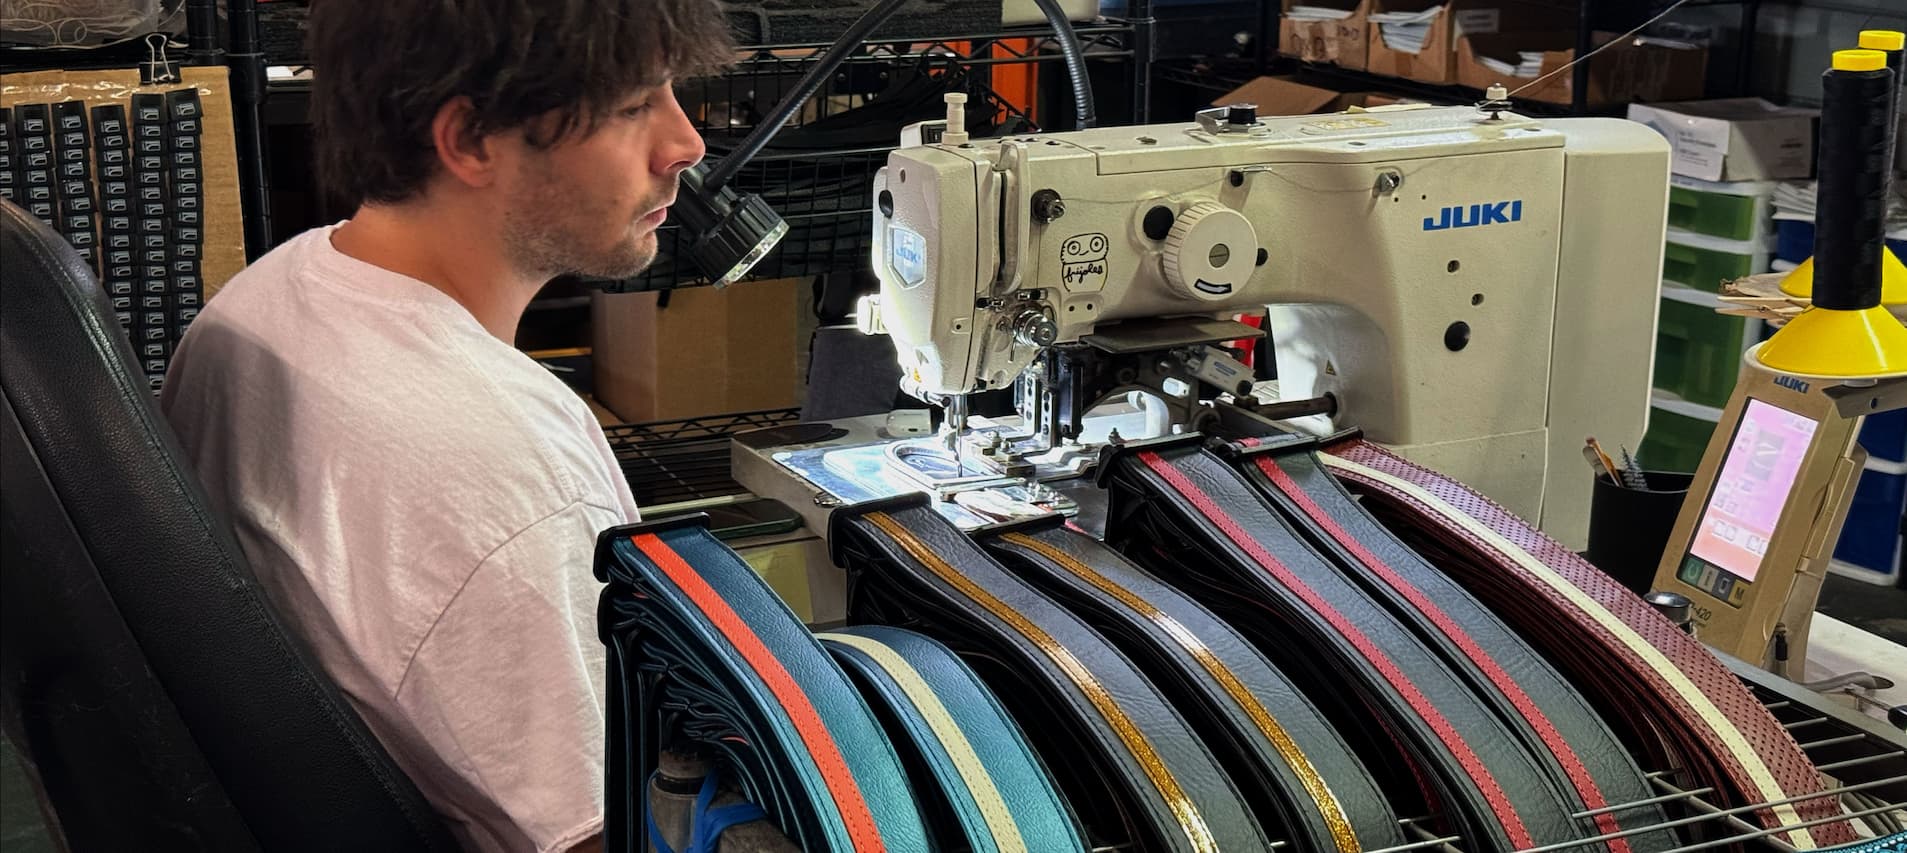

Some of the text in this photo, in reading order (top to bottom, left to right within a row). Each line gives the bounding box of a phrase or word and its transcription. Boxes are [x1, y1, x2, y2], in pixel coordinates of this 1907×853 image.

[1423, 200, 1522, 231] JUKI
[1063, 263, 1104, 284] frijoles
[1773, 376, 1810, 394] JUKI
